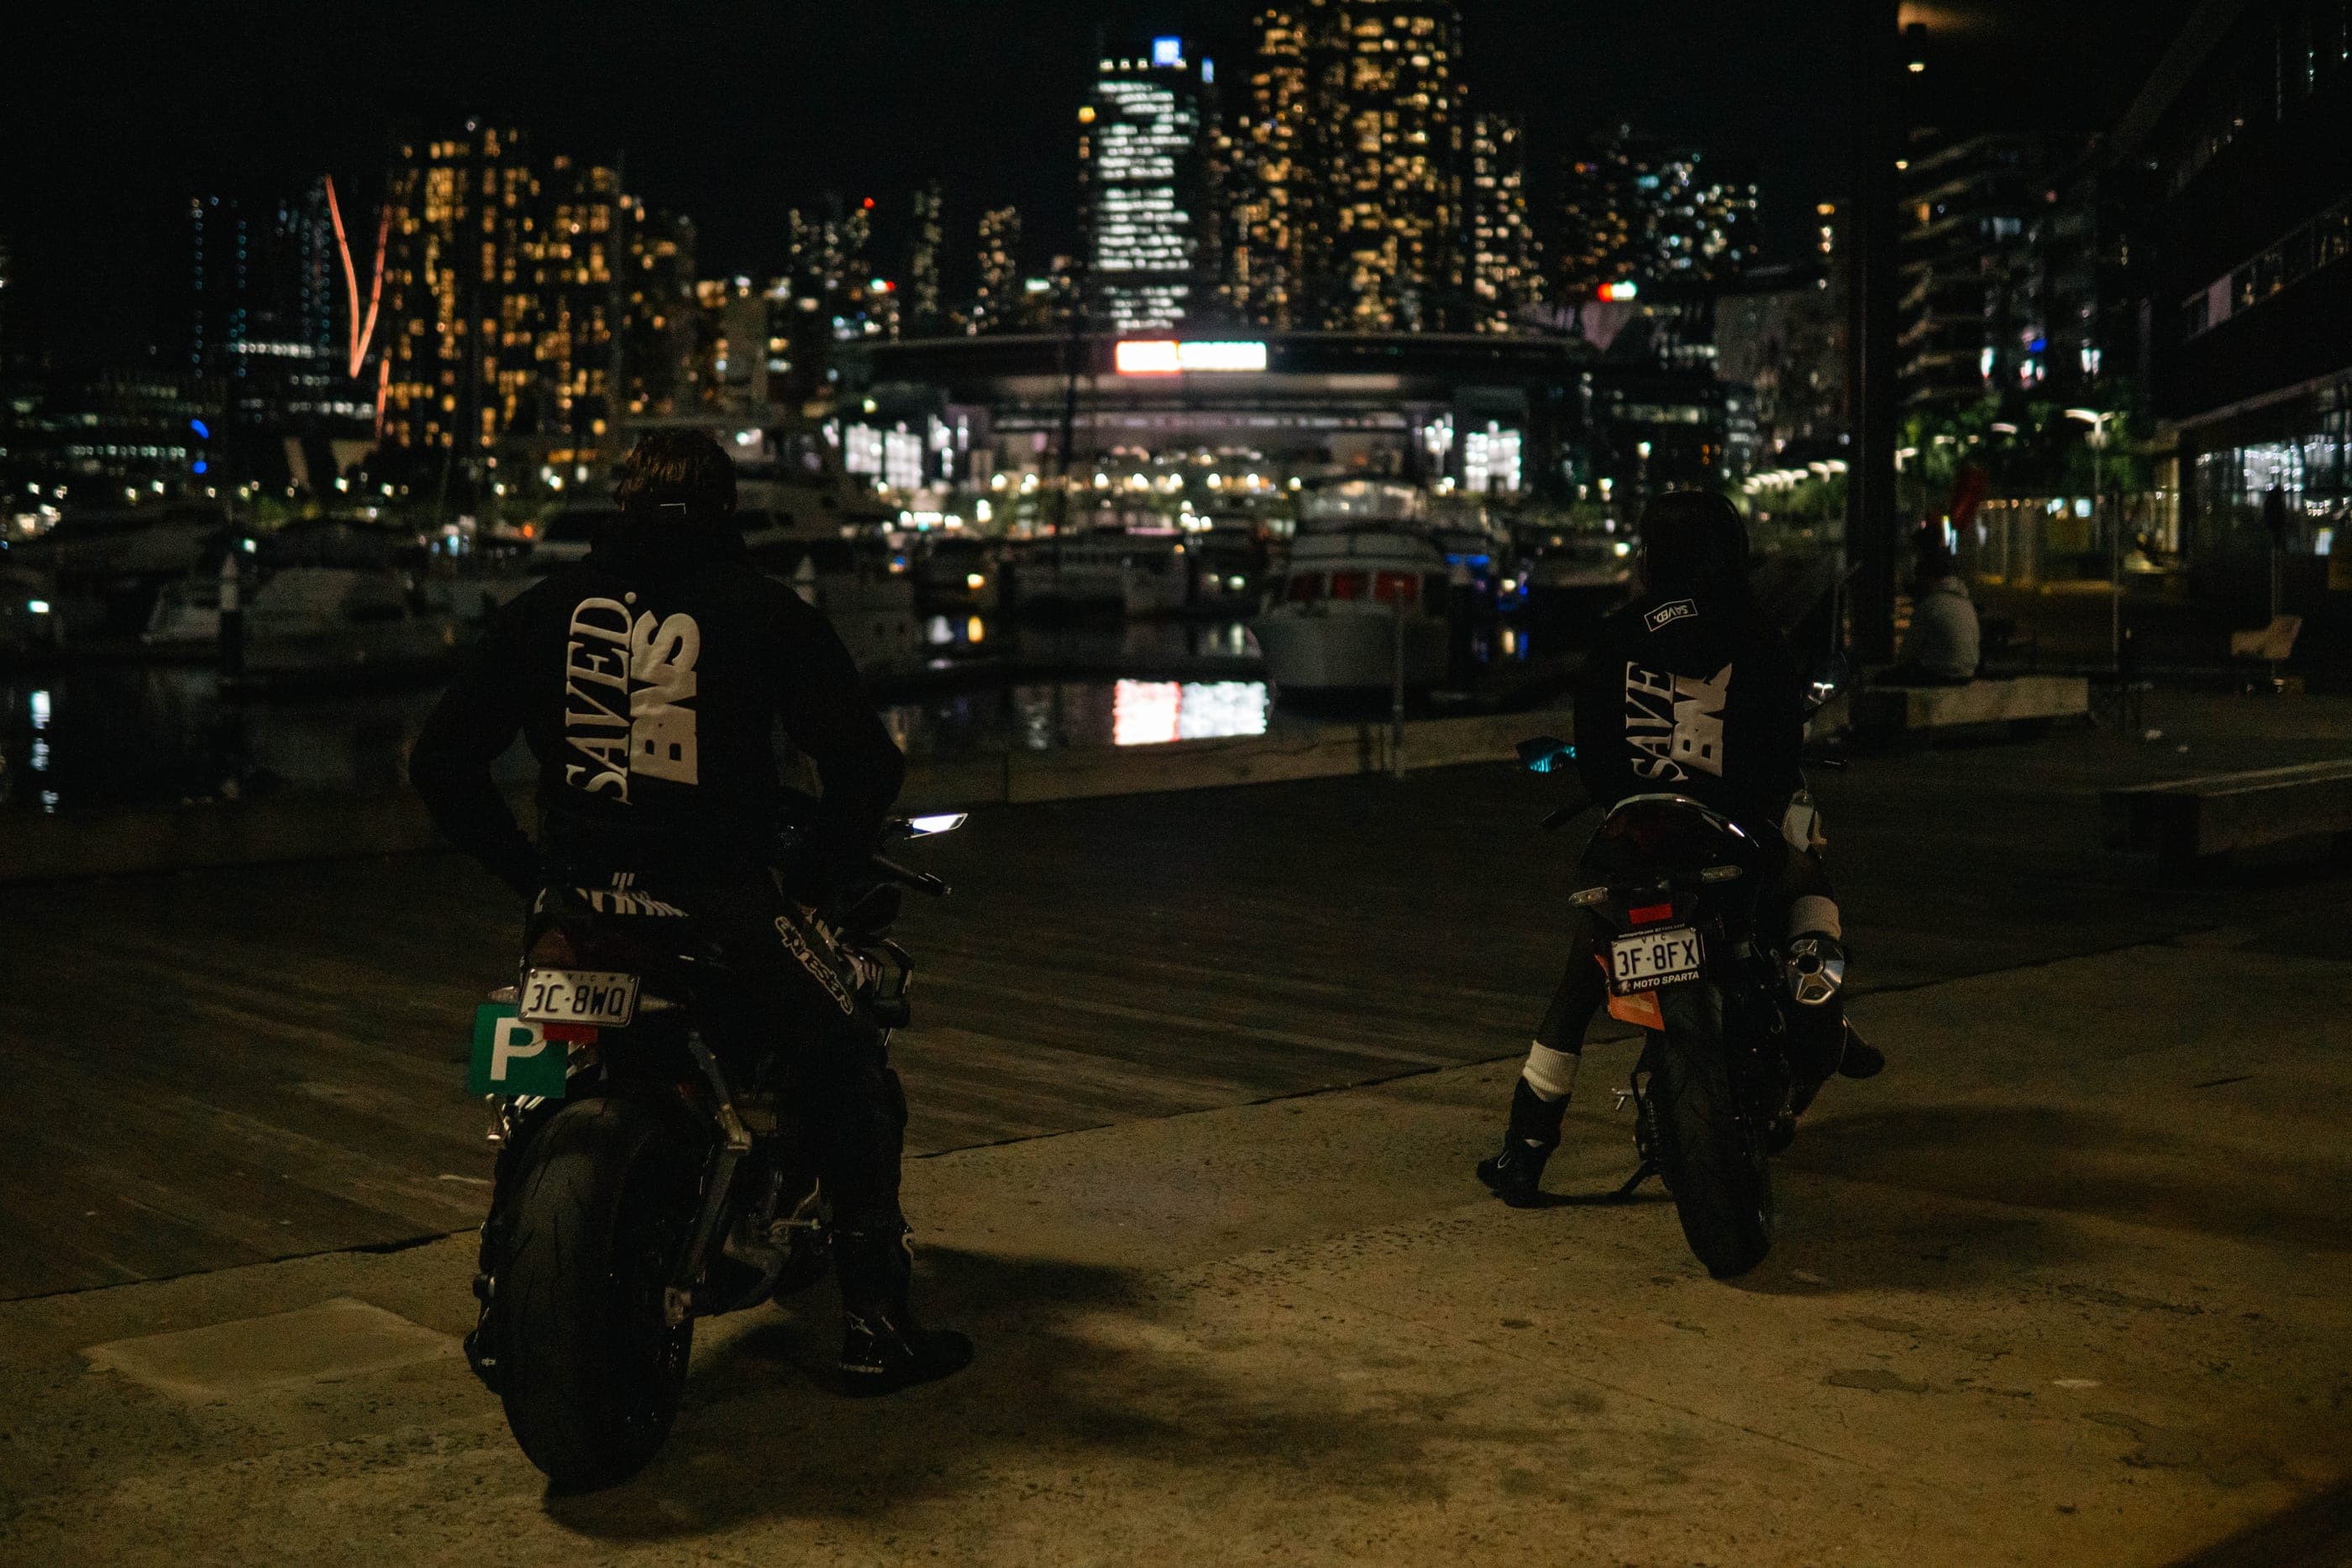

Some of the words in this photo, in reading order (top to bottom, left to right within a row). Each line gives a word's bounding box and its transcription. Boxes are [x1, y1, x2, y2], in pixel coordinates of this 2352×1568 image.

[565, 591, 637, 805] SAVED.
[630, 609, 701, 785] BNS
[1632, 978, 1661, 990] MOTO
[1662, 971, 1699, 985] SPARTA
[490, 1017, 547, 1081] P
